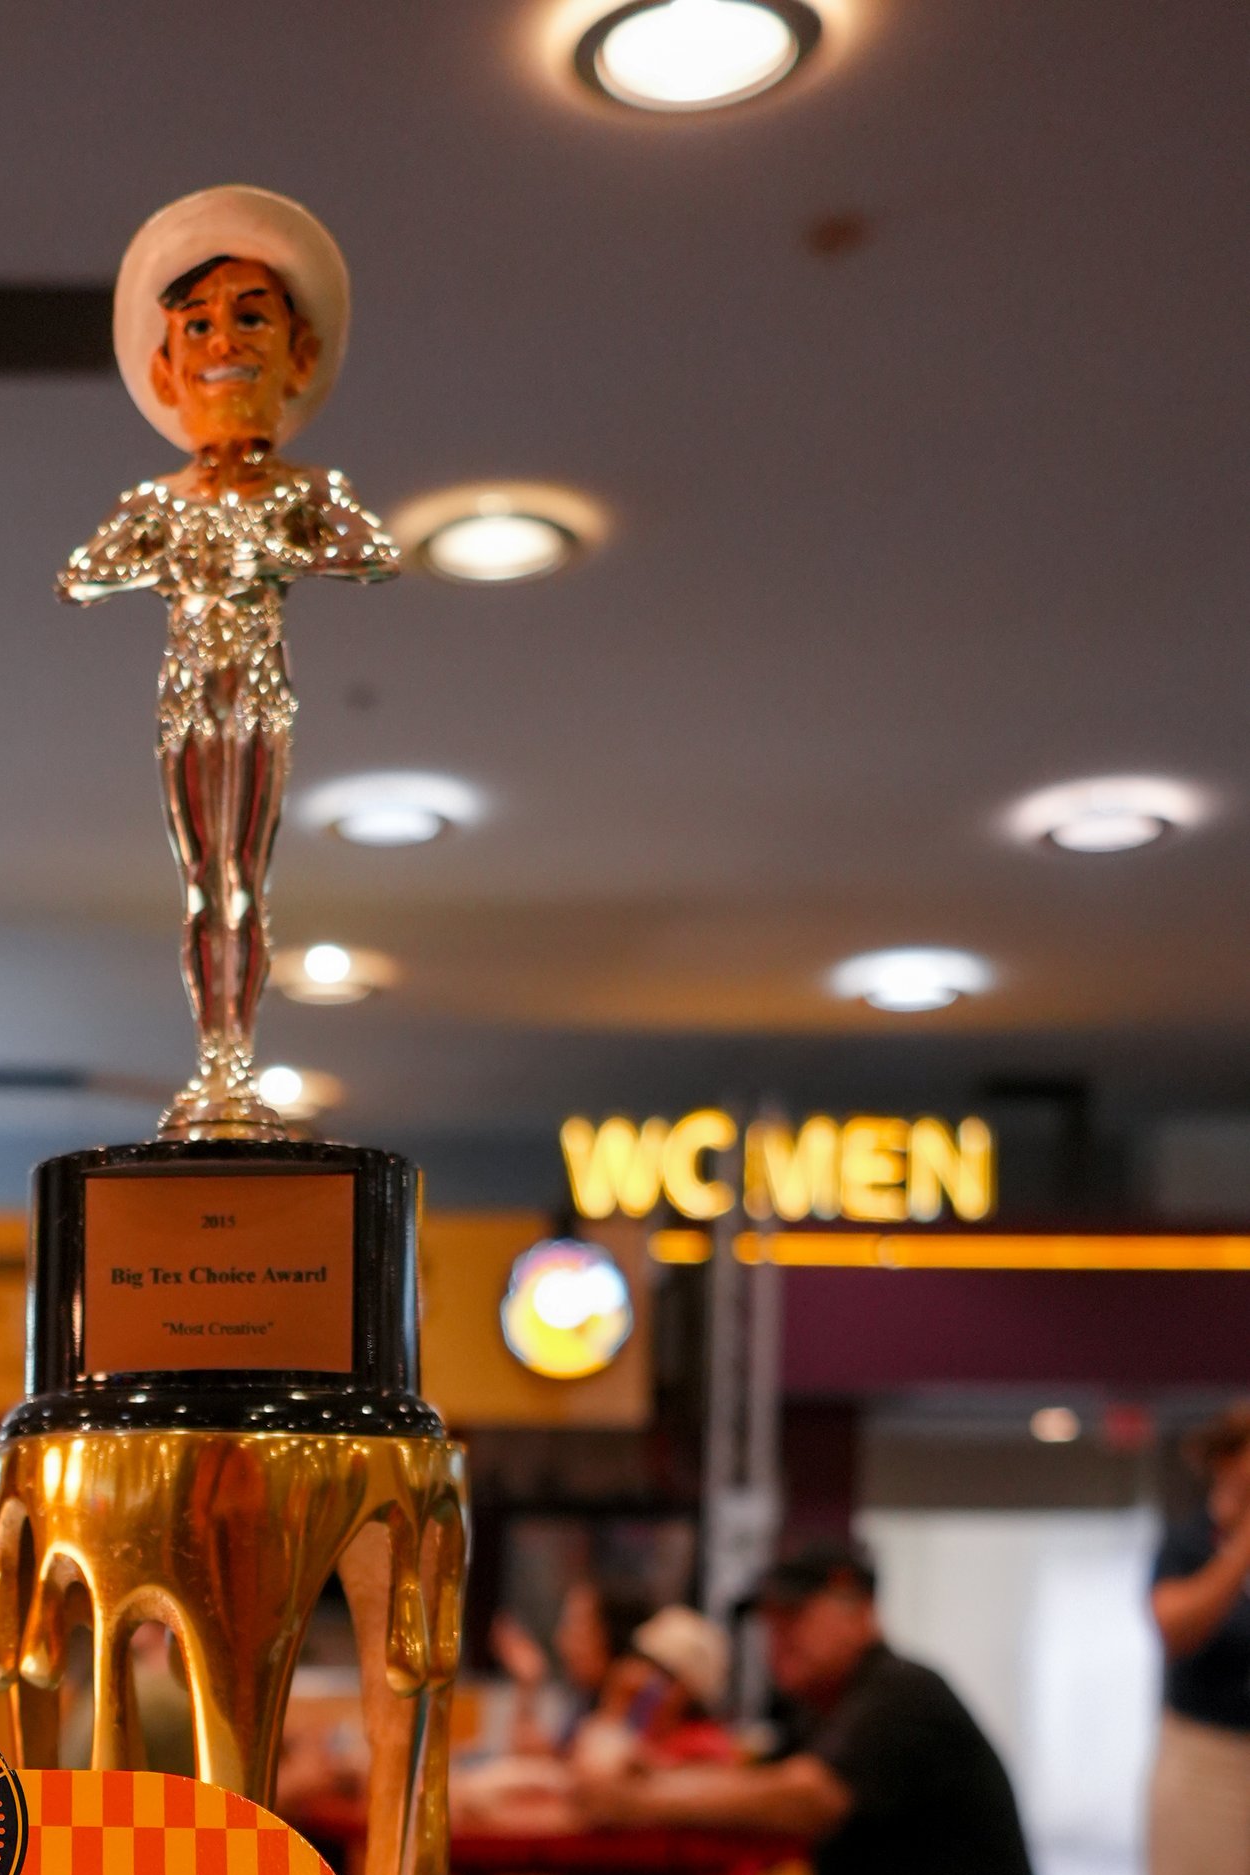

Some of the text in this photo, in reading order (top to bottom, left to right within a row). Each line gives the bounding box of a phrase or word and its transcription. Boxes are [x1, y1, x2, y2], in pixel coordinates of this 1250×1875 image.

[202, 1215, 237, 1229] 2015
[111, 1266, 328, 1289] Big Tex Choice Award
[162, 1321, 274, 1336] "Most Creative"
